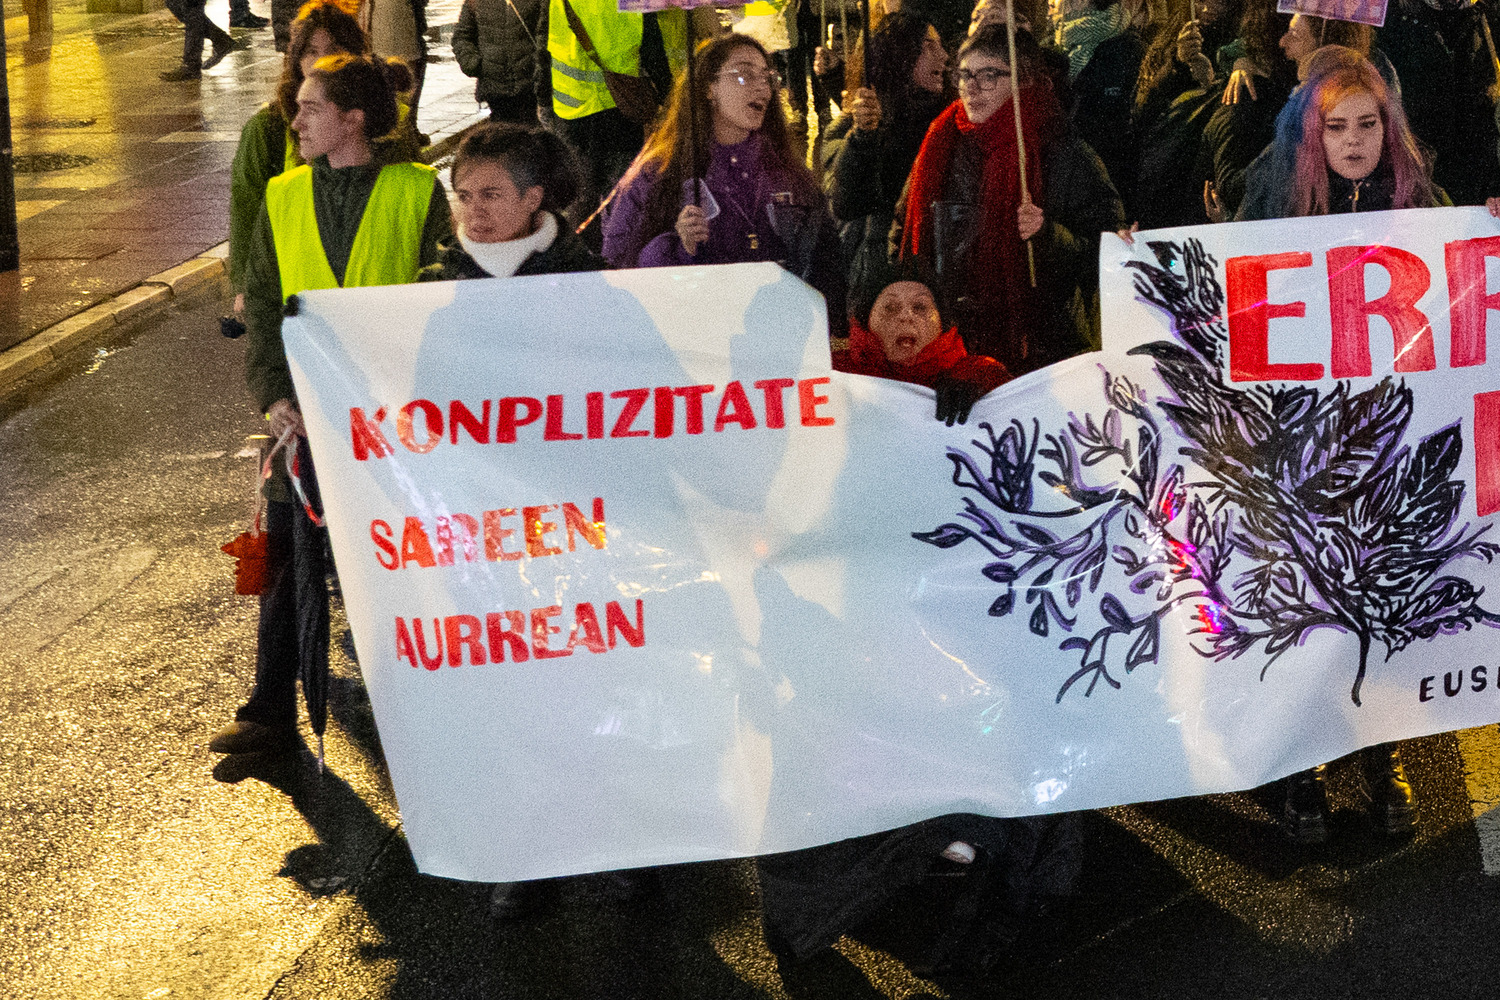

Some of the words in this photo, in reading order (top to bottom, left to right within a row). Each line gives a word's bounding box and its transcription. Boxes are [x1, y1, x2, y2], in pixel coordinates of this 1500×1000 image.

[350, 376, 836, 462] KONPLIZITATE
[369, 496, 607, 571] SAREEN
[395, 598, 647, 671] AURREAN
